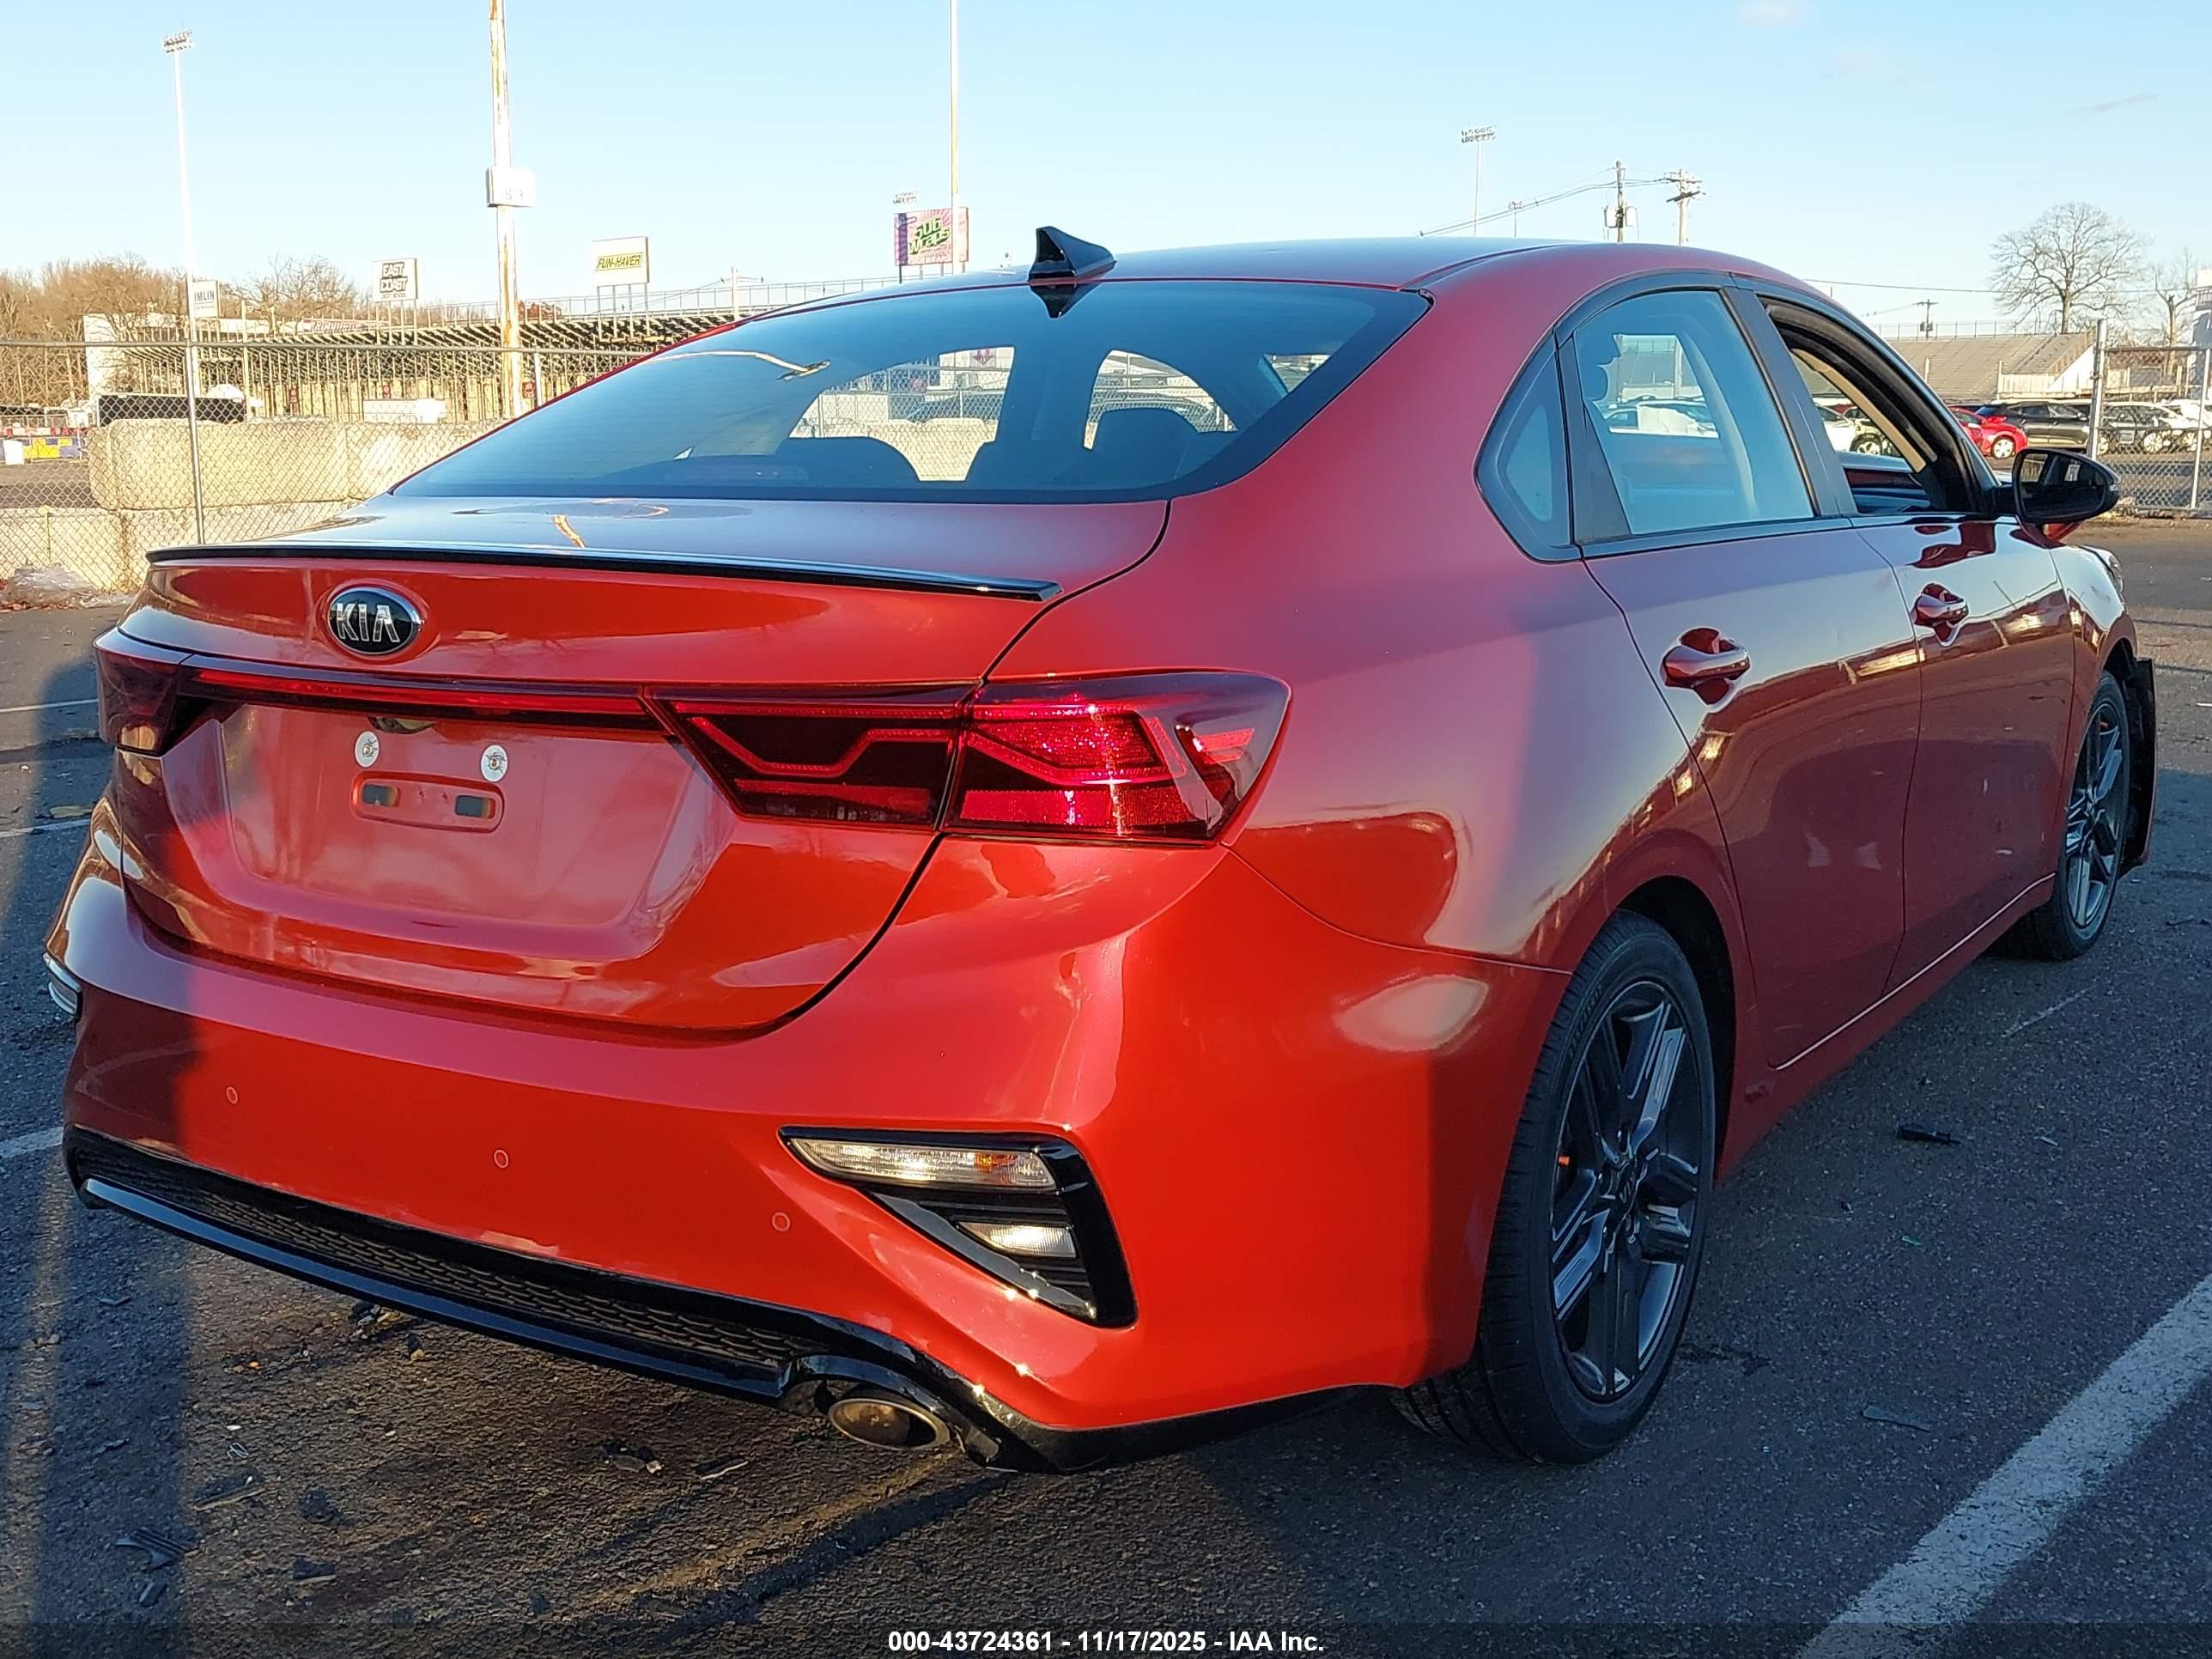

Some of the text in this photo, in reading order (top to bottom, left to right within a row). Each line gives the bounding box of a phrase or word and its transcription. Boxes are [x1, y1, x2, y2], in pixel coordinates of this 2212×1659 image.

[914, 215, 943, 240] 506
[382, 262, 405, 278] EAST
[597, 255, 641, 269] FUN-HAVER
[380, 276, 408, 293] COAST
[336, 603, 400, 643] KIA
